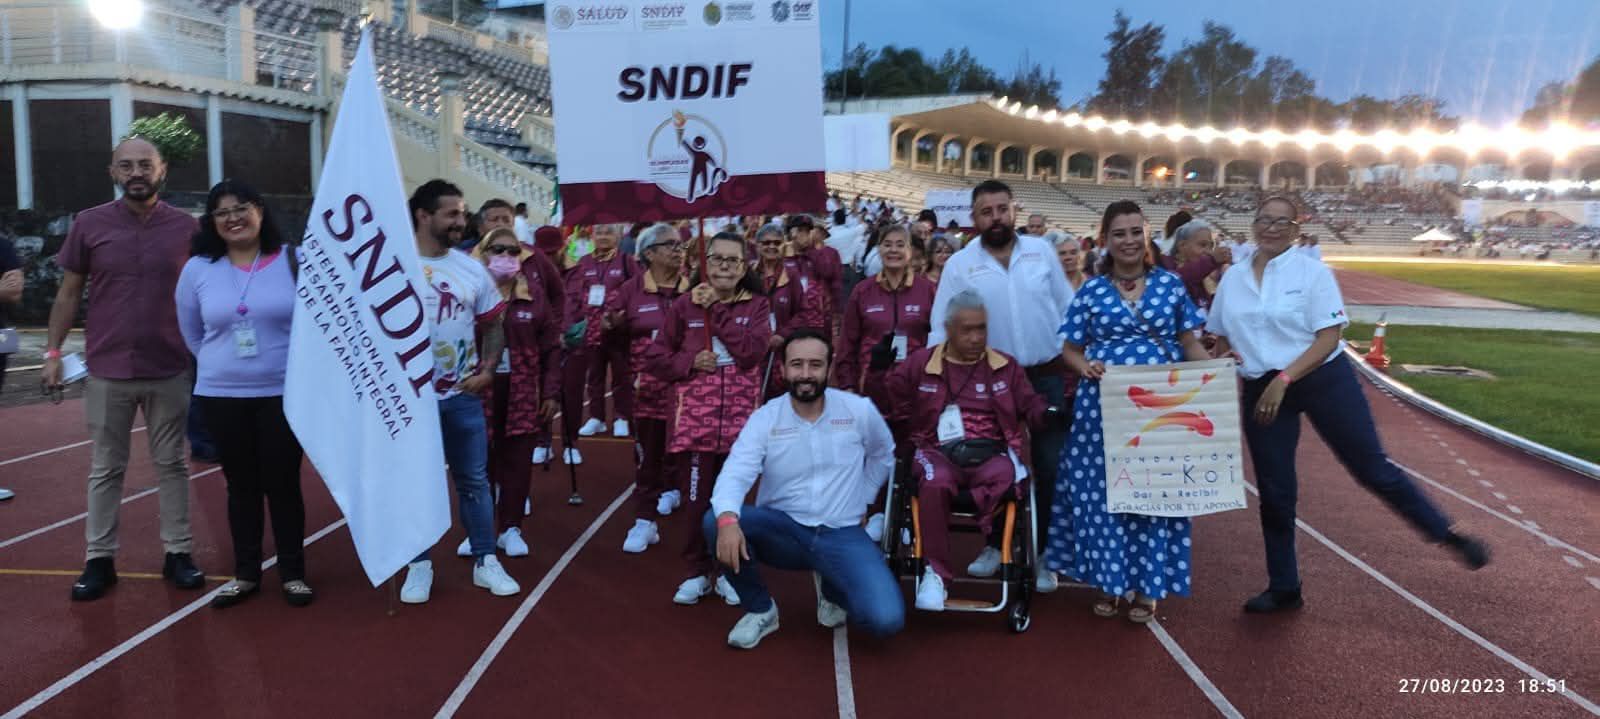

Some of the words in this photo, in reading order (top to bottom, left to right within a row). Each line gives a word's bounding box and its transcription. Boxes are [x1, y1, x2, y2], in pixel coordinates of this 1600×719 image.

[576, 7, 628, 21] SALUD
[641, 5, 686, 18] SNDIF
[617, 62, 753, 103] SNDIF
[303, 231, 346, 295] ISTEMA
[343, 295, 388, 381] NACIONAL
[385, 383, 413, 428] PARA
[297, 285, 316, 310] DE
[313, 312, 332, 336] LA
[328, 334, 364, 403] FAMILIA
[358, 361, 400, 441] INTEGRAL
[1133, 491, 1152, 499] Dar
[1178, 488, 1219, 498] Recibir
[1162, 503, 1183, 512] POR
[1185, 503, 1199, 511] TU
